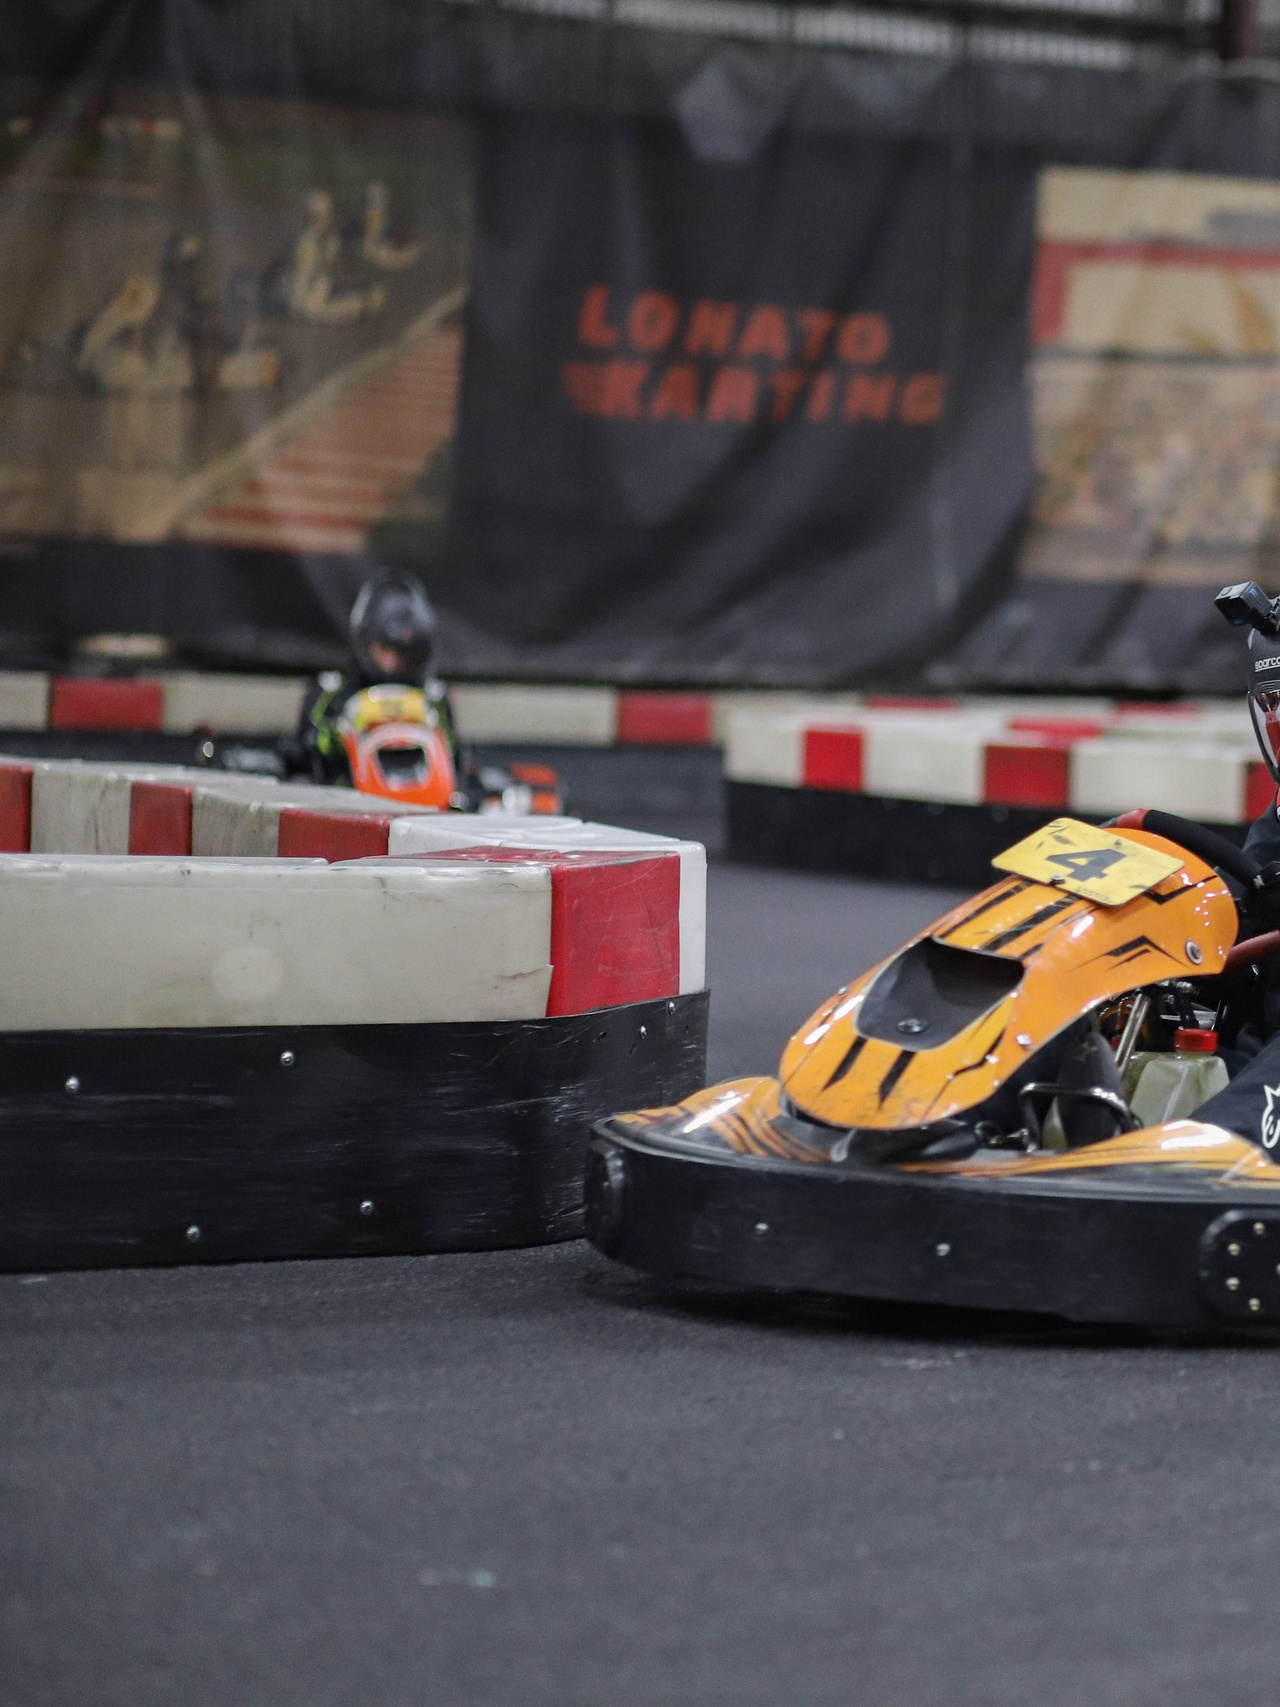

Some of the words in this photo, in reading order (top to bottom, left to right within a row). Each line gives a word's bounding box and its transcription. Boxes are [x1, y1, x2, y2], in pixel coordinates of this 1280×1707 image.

[577, 283, 891, 364] LONATO
[590, 357, 949, 427] KARTING
[1045, 849, 1128, 882] 4
